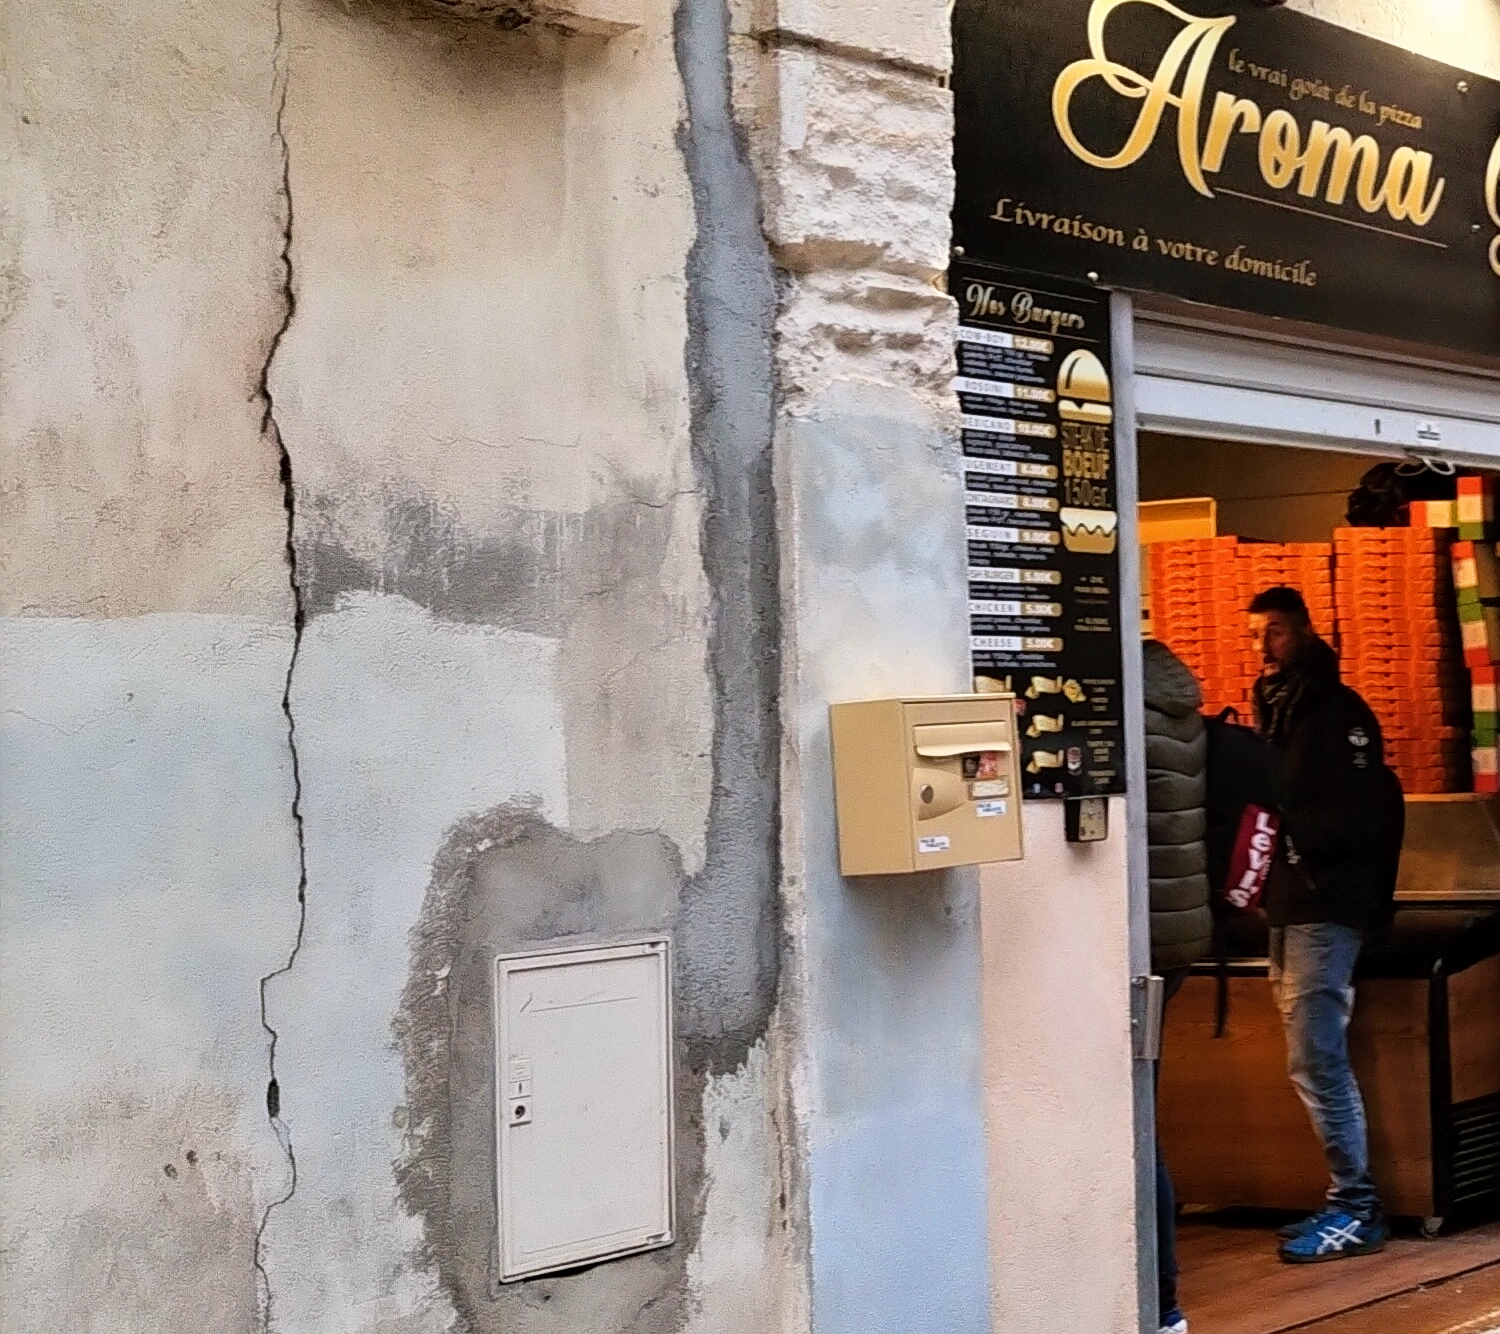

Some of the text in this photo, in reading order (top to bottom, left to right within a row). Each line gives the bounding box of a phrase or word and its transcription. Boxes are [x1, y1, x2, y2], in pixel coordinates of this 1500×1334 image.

[1247, 63, 1288, 87] vrai
[1335, 84, 1357, 108] de
[1358, 90, 1376, 115] la
[1375, 104, 1423, 129] pizza
[990, 199, 1317, 287] Livraison à votre domicile
[966, 283, 1085, 335] Nos Burgers
[972, 637, 1013, 649] CHEESE
